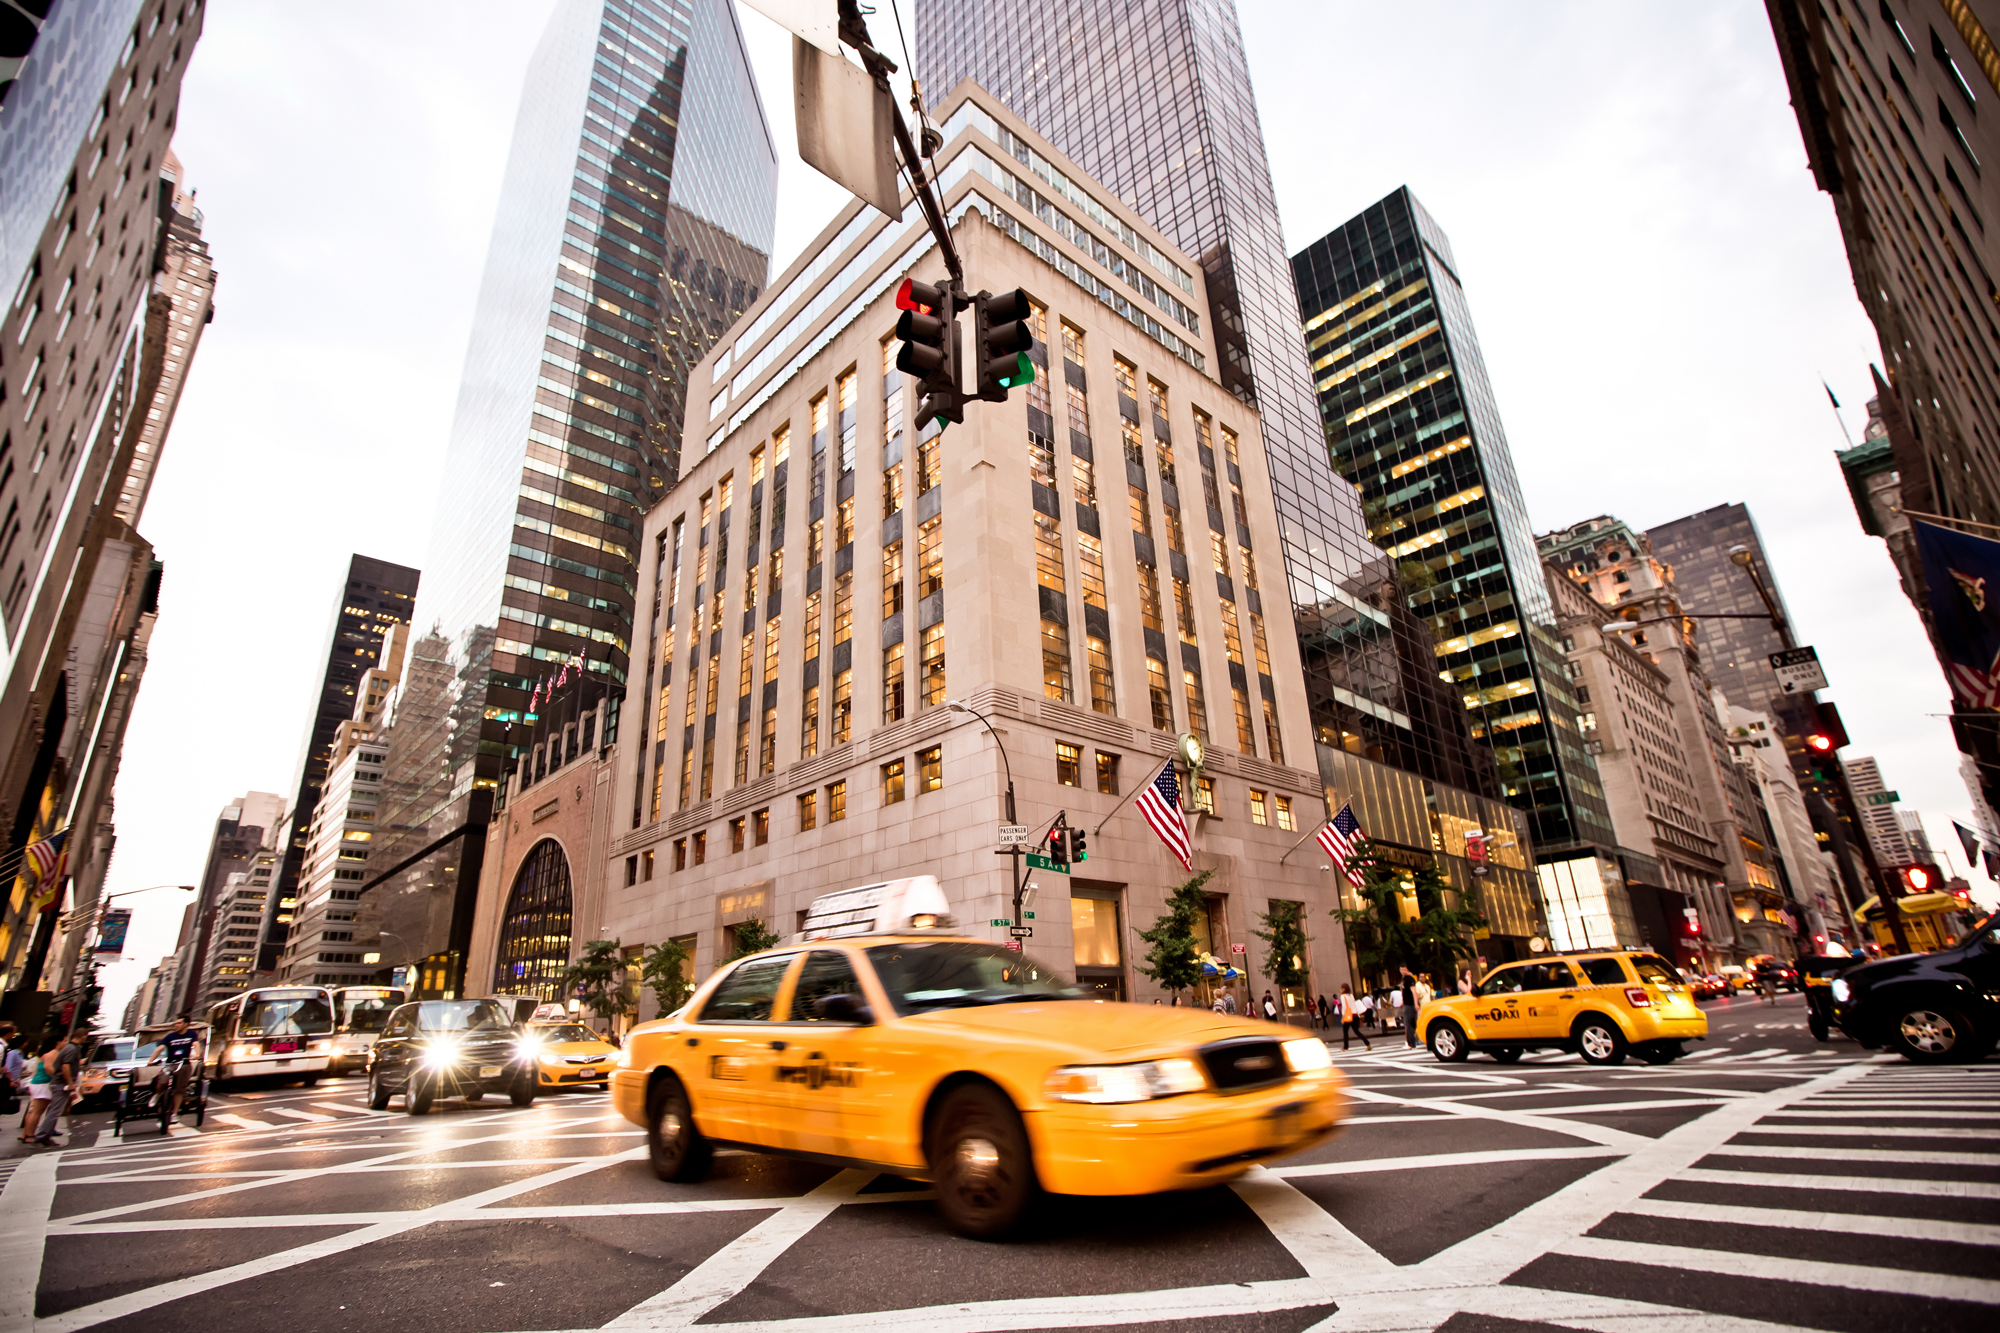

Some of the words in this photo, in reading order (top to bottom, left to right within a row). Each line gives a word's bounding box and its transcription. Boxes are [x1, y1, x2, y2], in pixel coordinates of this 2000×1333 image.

[1781, 663, 1813, 675] BUSES
[1793, 671, 1818, 681] ONLY
[1040, 857, 1045, 867] 5
[1474, 1013, 1490, 1021] NYC
[270, 1042, 299, 1052] GIRLS
